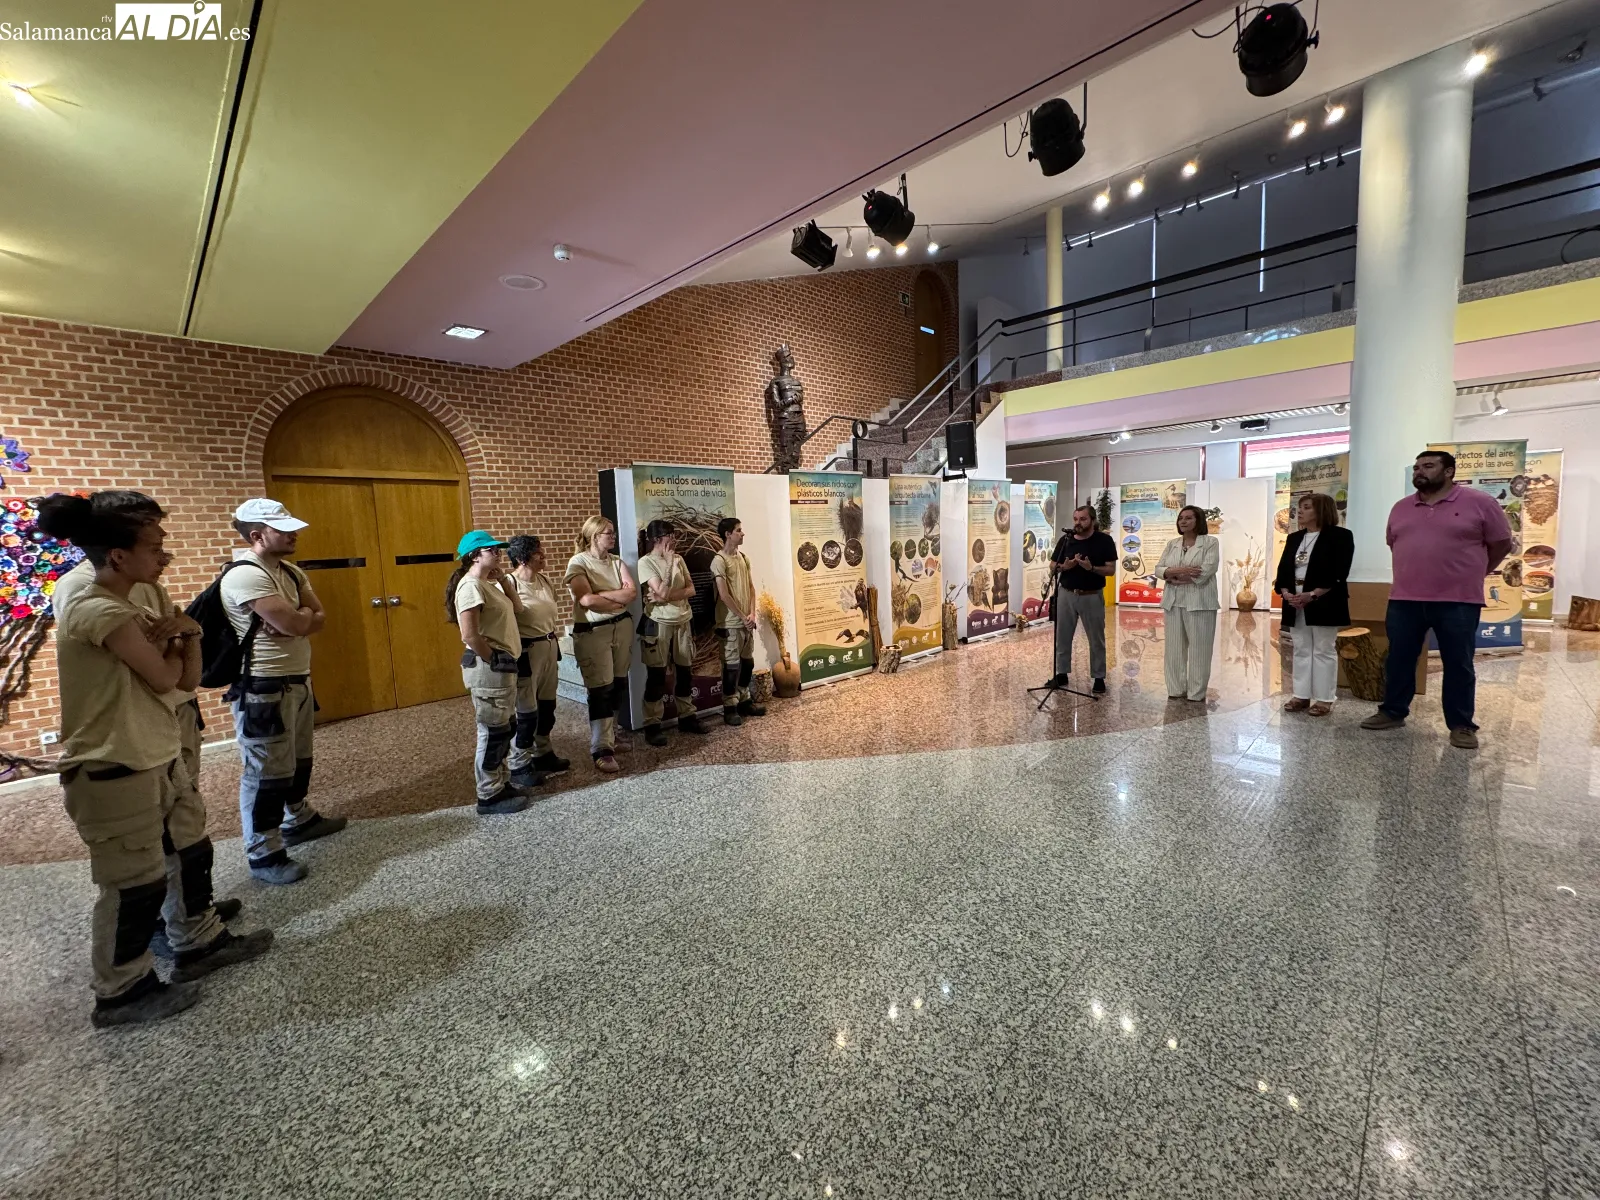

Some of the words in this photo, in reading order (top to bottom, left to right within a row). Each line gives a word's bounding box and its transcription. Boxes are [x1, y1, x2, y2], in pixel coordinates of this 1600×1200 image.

[1485, 449, 1497, 458] del
[1499, 450, 1516, 458] aire:
[1474, 460, 1484, 469] de
[1486, 459, 1496, 468] las
[1497, 460, 1514, 468] aves
[1326, 469, 1343, 478] ciudad
[650, 474, 666, 485] Los
[667, 475, 689, 485] nidos
[691, 478, 721, 486] cuentan
[796, 479, 820, 487] Decoran
[832, 479, 847, 488] nidos
[646, 487, 675, 496] nuestra
[676, 486, 699, 497] forma
[701, 487, 710, 497] de
[711, 487, 727, 497] vida
[796, 488, 823, 499] plásticos
[824, 489, 846, 497] blancos
[1134, 486, 1158, 494] arquitecto
